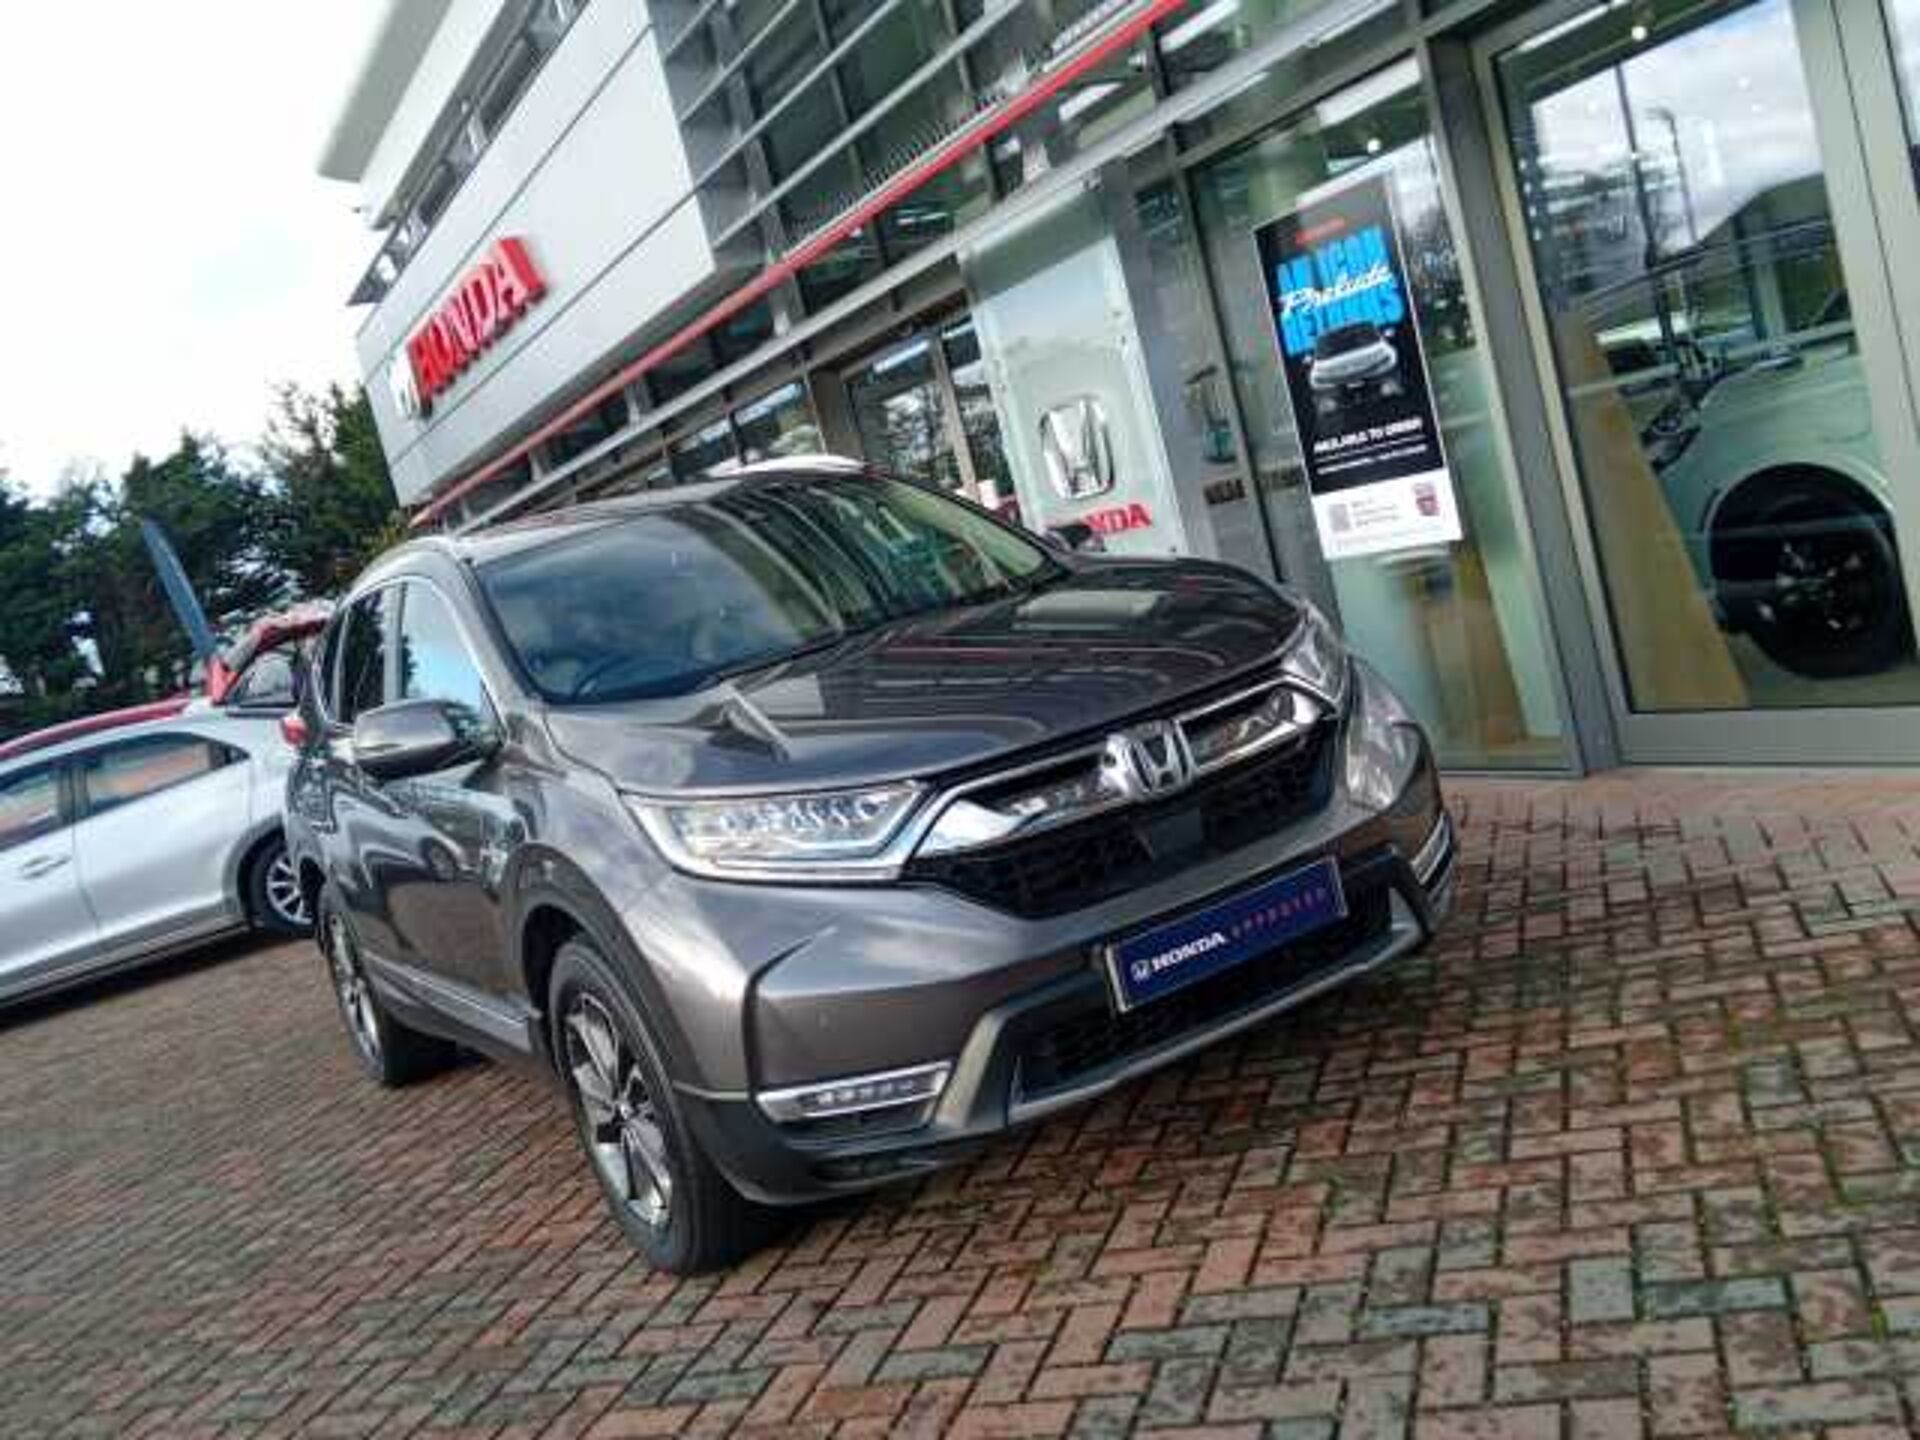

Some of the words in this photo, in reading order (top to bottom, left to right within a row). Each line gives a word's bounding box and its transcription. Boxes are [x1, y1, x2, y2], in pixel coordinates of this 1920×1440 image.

[1277, 262, 1396, 318] Prelude
[405, 236, 544, 398] HONDA
[1085, 503, 1153, 535] NDA
[1150, 931, 1227, 972] HONDA
